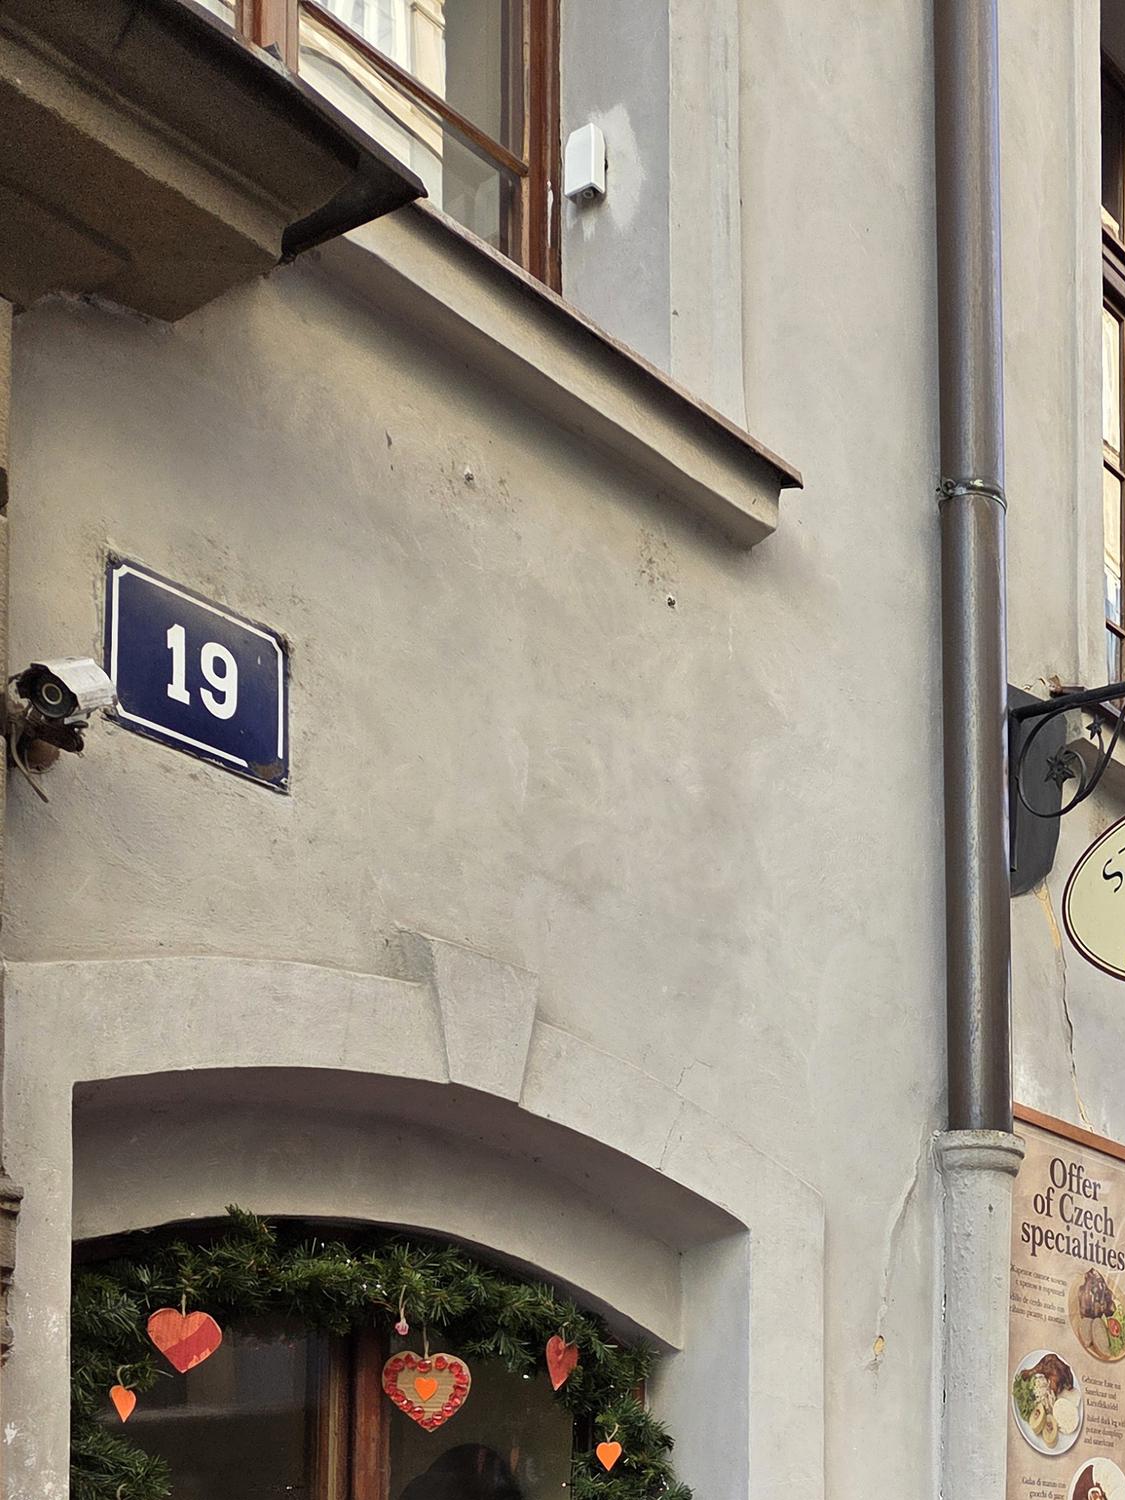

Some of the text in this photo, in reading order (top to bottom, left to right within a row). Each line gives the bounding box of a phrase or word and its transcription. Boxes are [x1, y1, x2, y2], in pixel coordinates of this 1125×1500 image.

[167, 624, 238, 720] 19
[1050, 1158, 1101, 1201] Offer
[1033, 1186, 1115, 1238] of Czech
[1021, 1222, 1125, 1271] specialities
